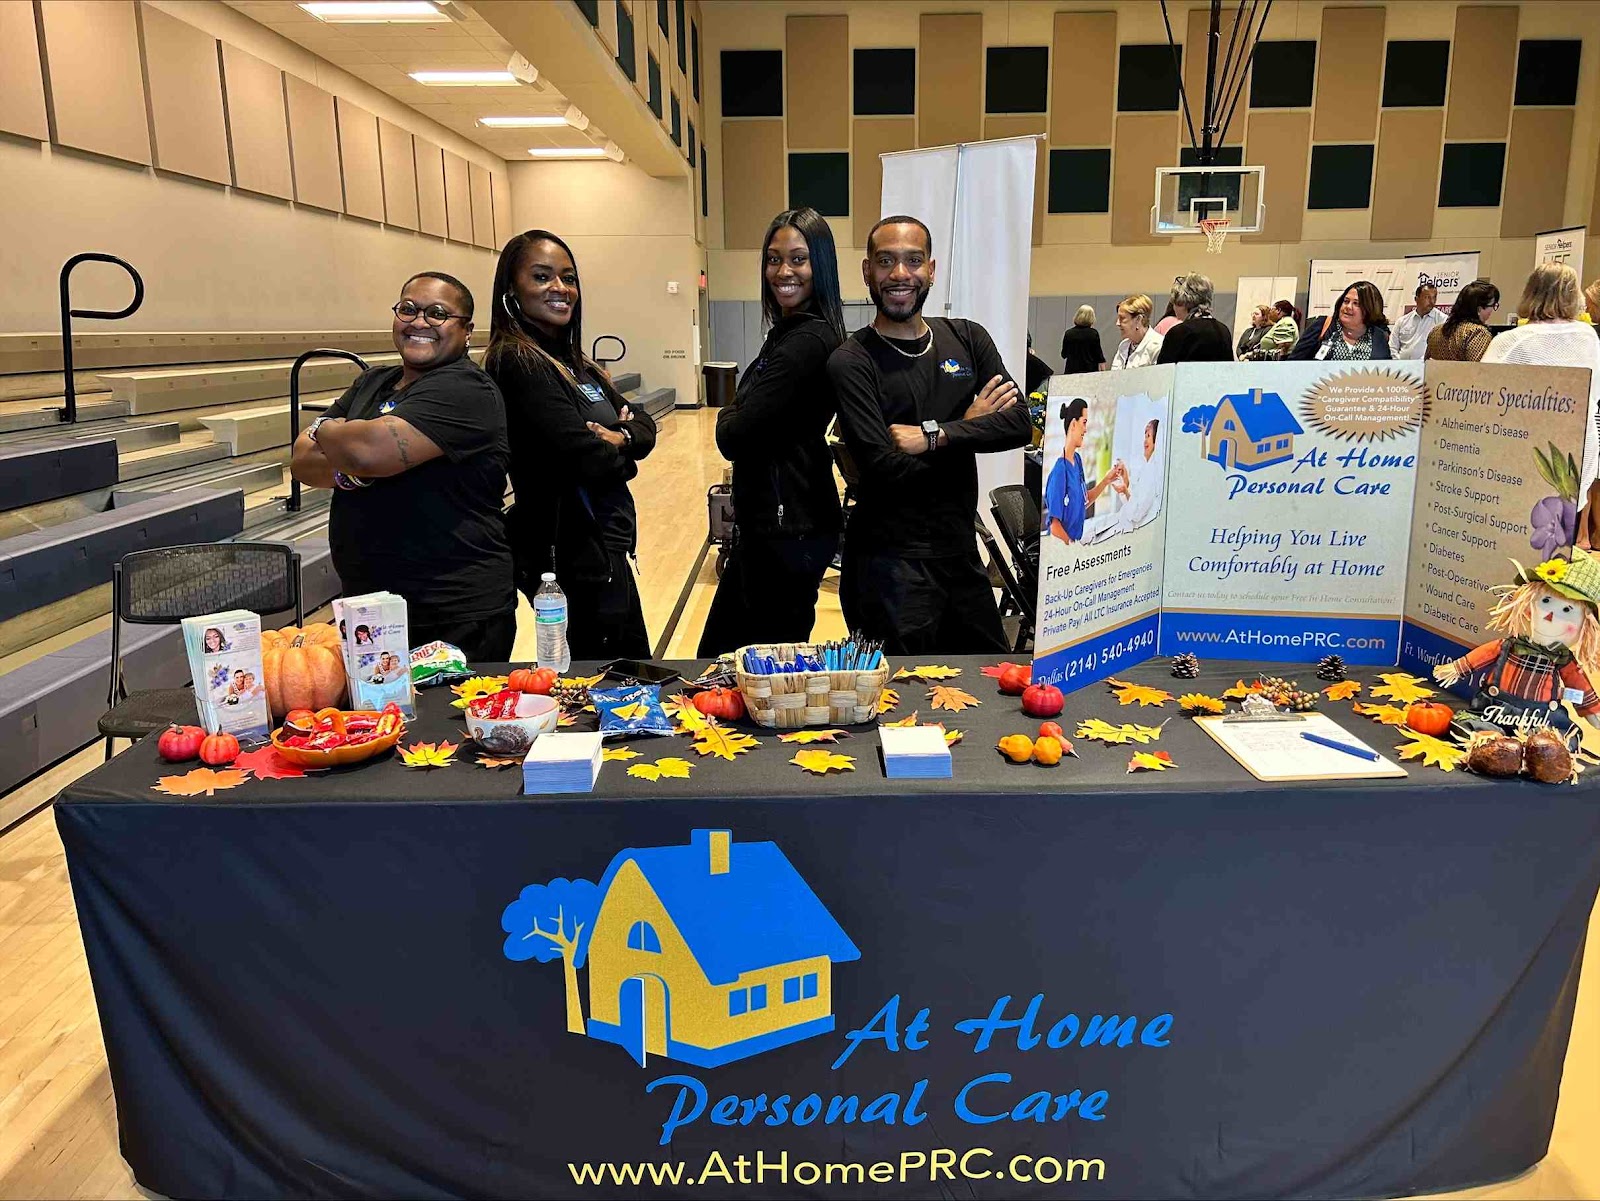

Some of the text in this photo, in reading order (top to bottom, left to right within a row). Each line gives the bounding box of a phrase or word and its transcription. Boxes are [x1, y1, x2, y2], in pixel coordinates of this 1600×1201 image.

[1420, 275, 1459, 288] Helpers
[1437, 271, 1460, 279] SENIOR
[1344, 386, 1375, 394] Provide
[1386, 386, 1409, 394] 100%
[1435, 382, 1577, 417] Caregiver Specialties:
[1355, 414, 1410, 423] Management!
[1440, 416, 1529, 440] Alzheimer's Disease
[1291, 446, 1416, 474] At Home
[1439, 438, 1480, 455] Dementia
[1437, 459, 1523, 486] Parkinson's Disease
[1225, 474, 1392, 500] Personal Care
[1435, 480, 1500, 506] Stroke Support
[1433, 501, 1528, 535] Post-Surgical Support
[1209, 525, 1367, 553] Helping You Live
[1431, 522, 1497, 550] Cancer Support
[1046, 544, 1132, 581] Free Assessments
[1429, 542, 1465, 563] Diabetes
[1188, 554, 1385, 582] Comfortably at Home
[1427, 562, 1489, 593] Post-Operative
[1044, 562, 1153, 606] Back-Up Caregivers for Emergencies
[1167, 590, 1196, 598] Contact
[1207, 591, 1228, 601] today
[1230, 592, 1238, 600] to
[1240, 591, 1270, 600] schedule
[1271, 594, 1289, 603] your
[1291, 594, 1308, 602] Free
[1319, 594, 1342, 603] Home
[1344, 595, 1396, 604] Consultation!
[1425, 584, 1476, 611] Wound Care
[1042, 623, 1067, 637] Private
[1083, 611, 1093, 624] All
[1094, 606, 1105, 620] LTC
[1105, 599, 1133, 615] Insurance
[1133, 585, 1160, 604] Accepted
[1043, 583, 1136, 622] 24-Hour On-Call Management
[1423, 603, 1479, 634] Diabetic Care
[1176, 629, 1386, 650] www.AtHomePRC.com
[1404, 641, 1414, 657] Ft.
[1417, 646, 1440, 666] Worth
[1038, 629, 1154, 687] Dallas (214) 540-4940
[1480, 705, 1551, 733] Thankful
[833, 992, 1173, 1070] At Home
[646, 1072, 1108, 1146] Personal Care
[567, 1146, 1107, 1186] www.AtHomePRC.com
